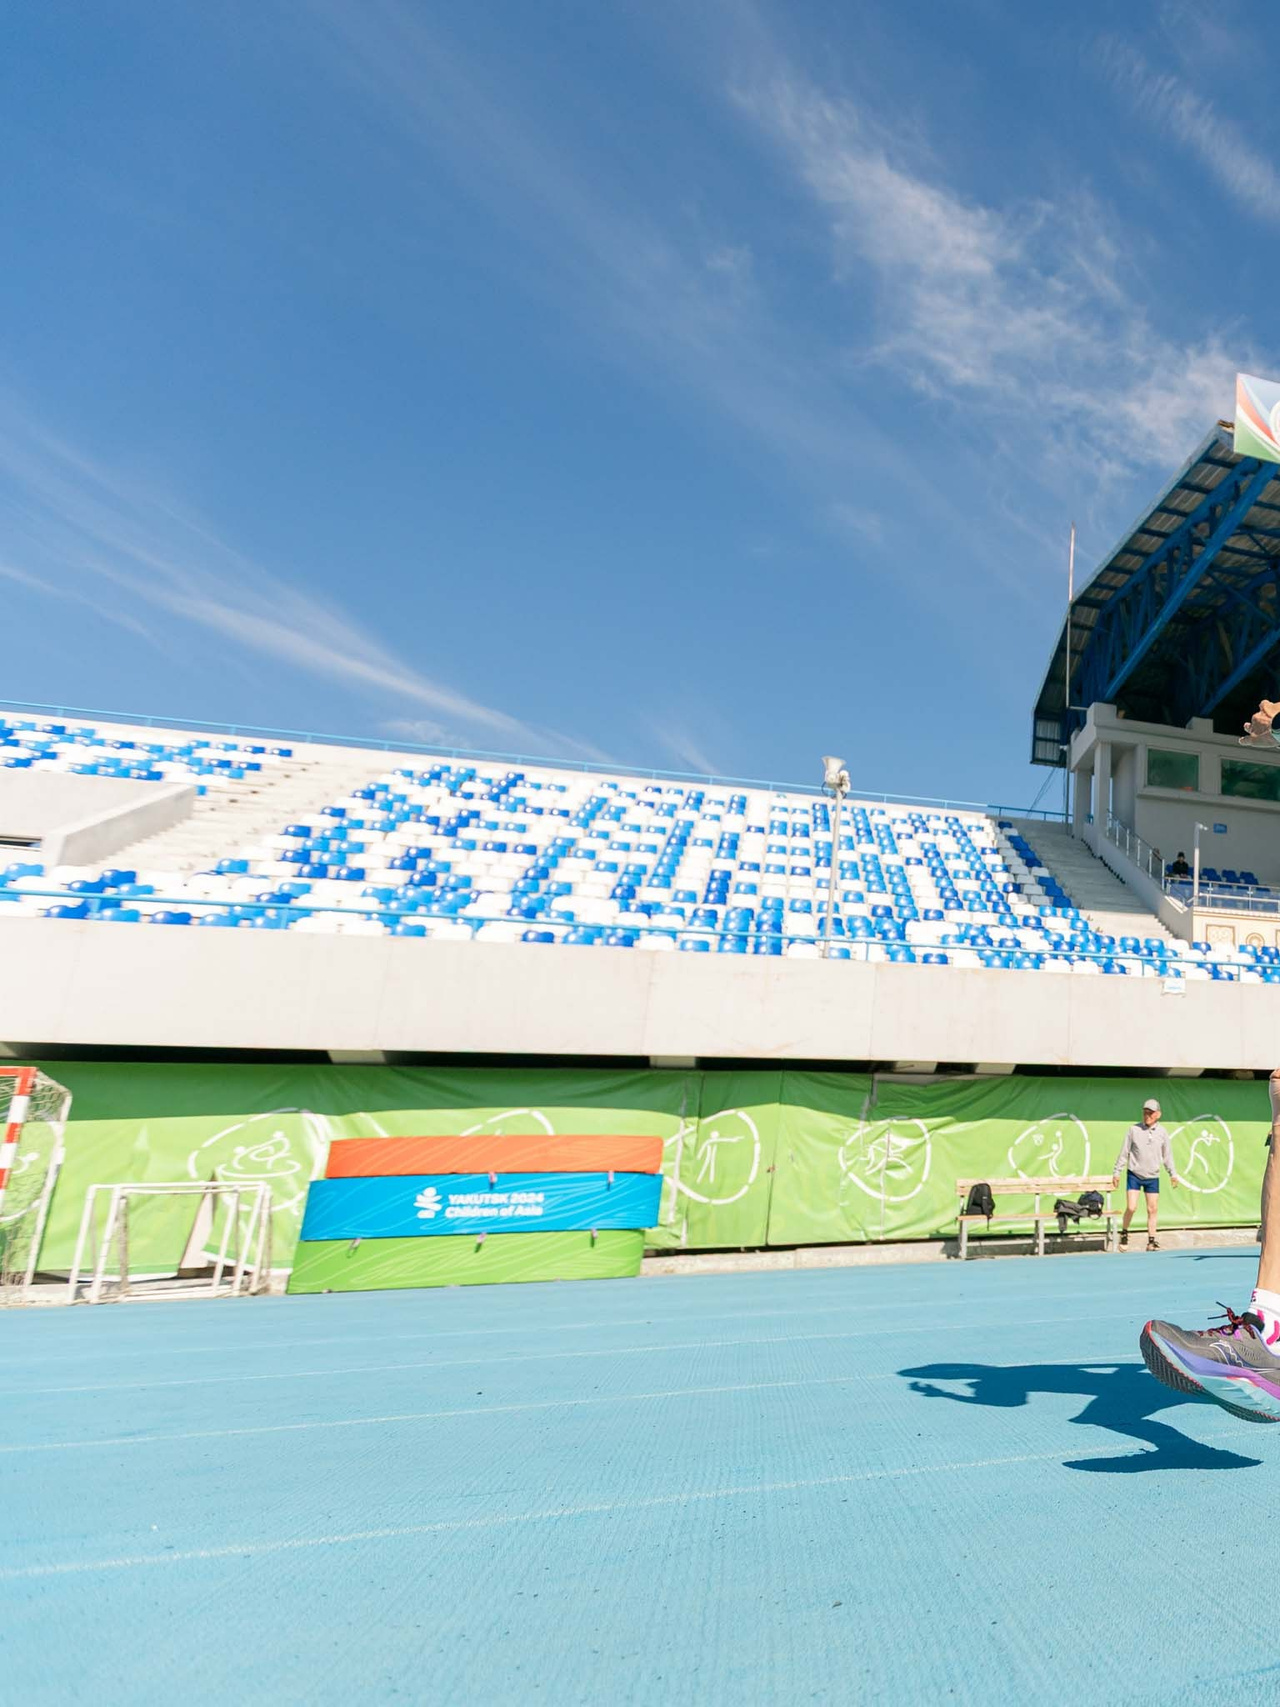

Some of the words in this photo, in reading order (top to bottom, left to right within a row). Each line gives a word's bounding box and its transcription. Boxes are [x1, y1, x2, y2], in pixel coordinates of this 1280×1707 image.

[448, 1193, 509, 1205] YAKUTSK
[445, 1205, 499, 1218] Children
[499, 1206, 514, 1217] of
[514, 1204, 544, 1217] Asia
